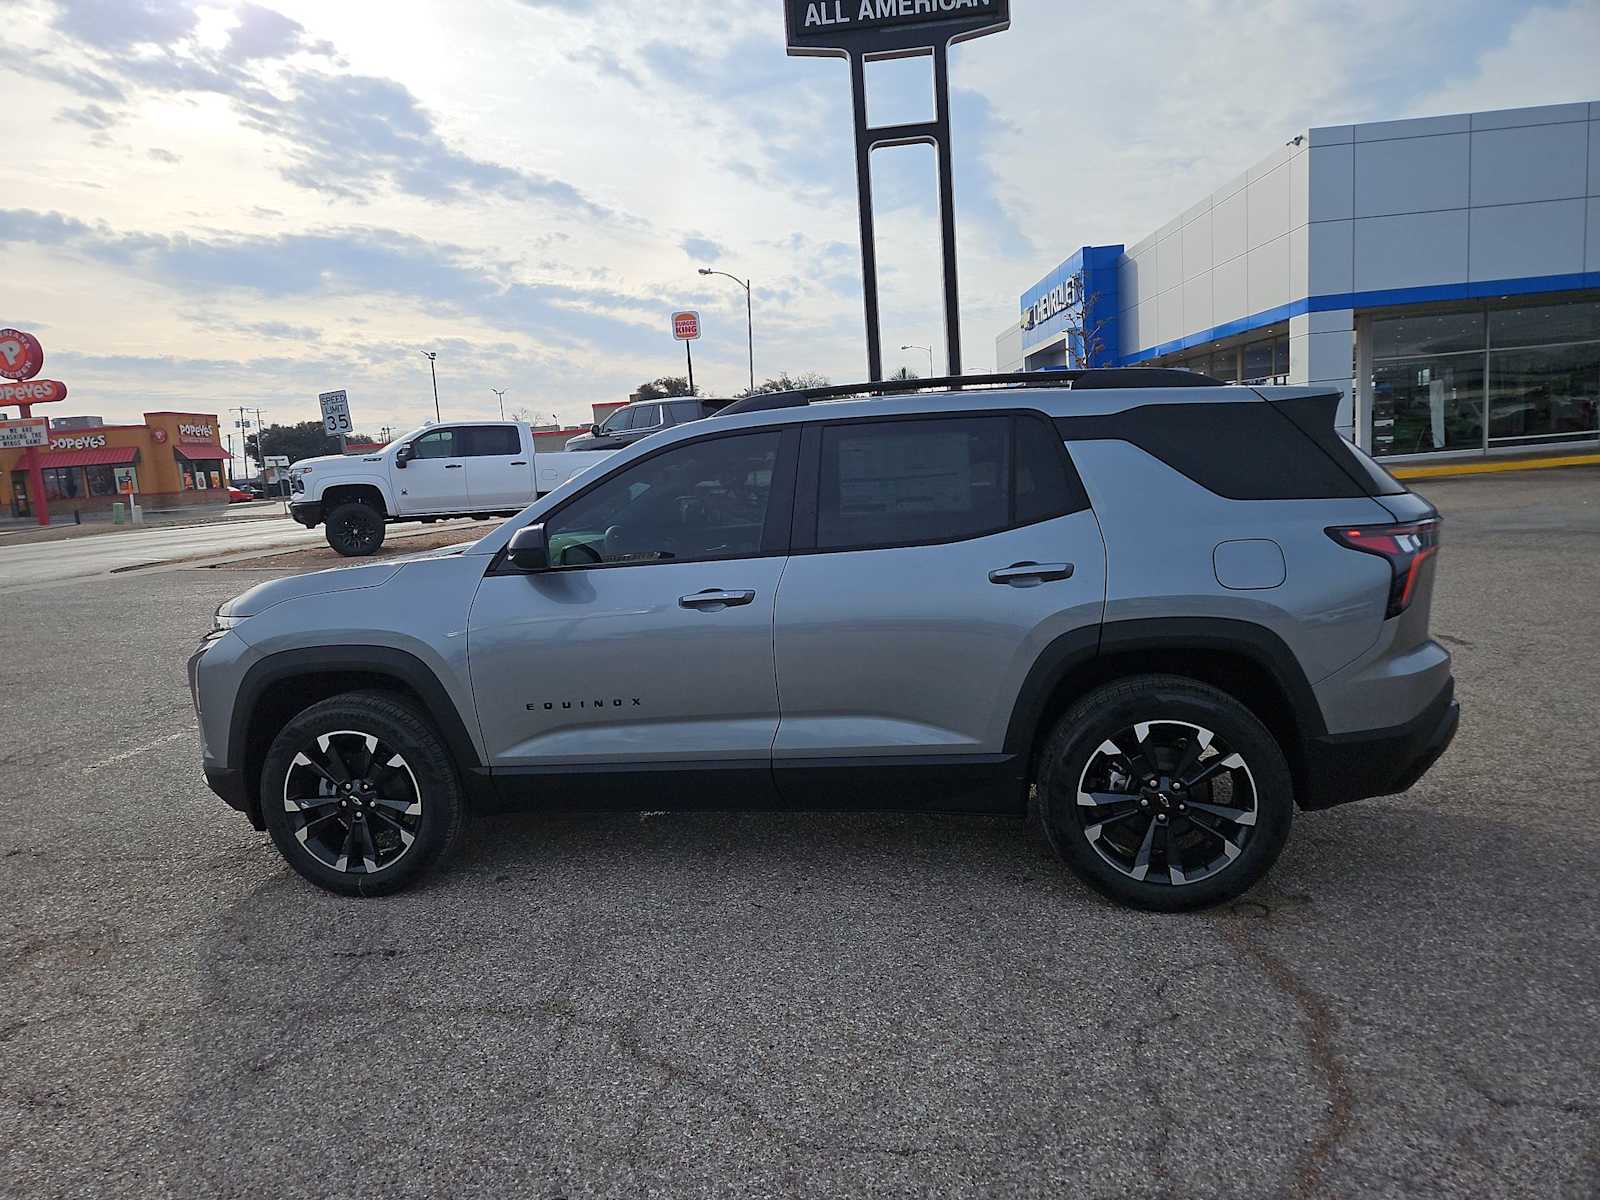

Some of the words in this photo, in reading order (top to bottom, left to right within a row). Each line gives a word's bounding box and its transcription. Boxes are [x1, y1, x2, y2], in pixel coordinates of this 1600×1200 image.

[804, 0, 850, 27] ALL
[675, 325, 697, 334] KING
[320, 394, 346, 406] SPEED
[325, 404, 344, 415] LIMIT
[327, 414, 349, 431] 35
